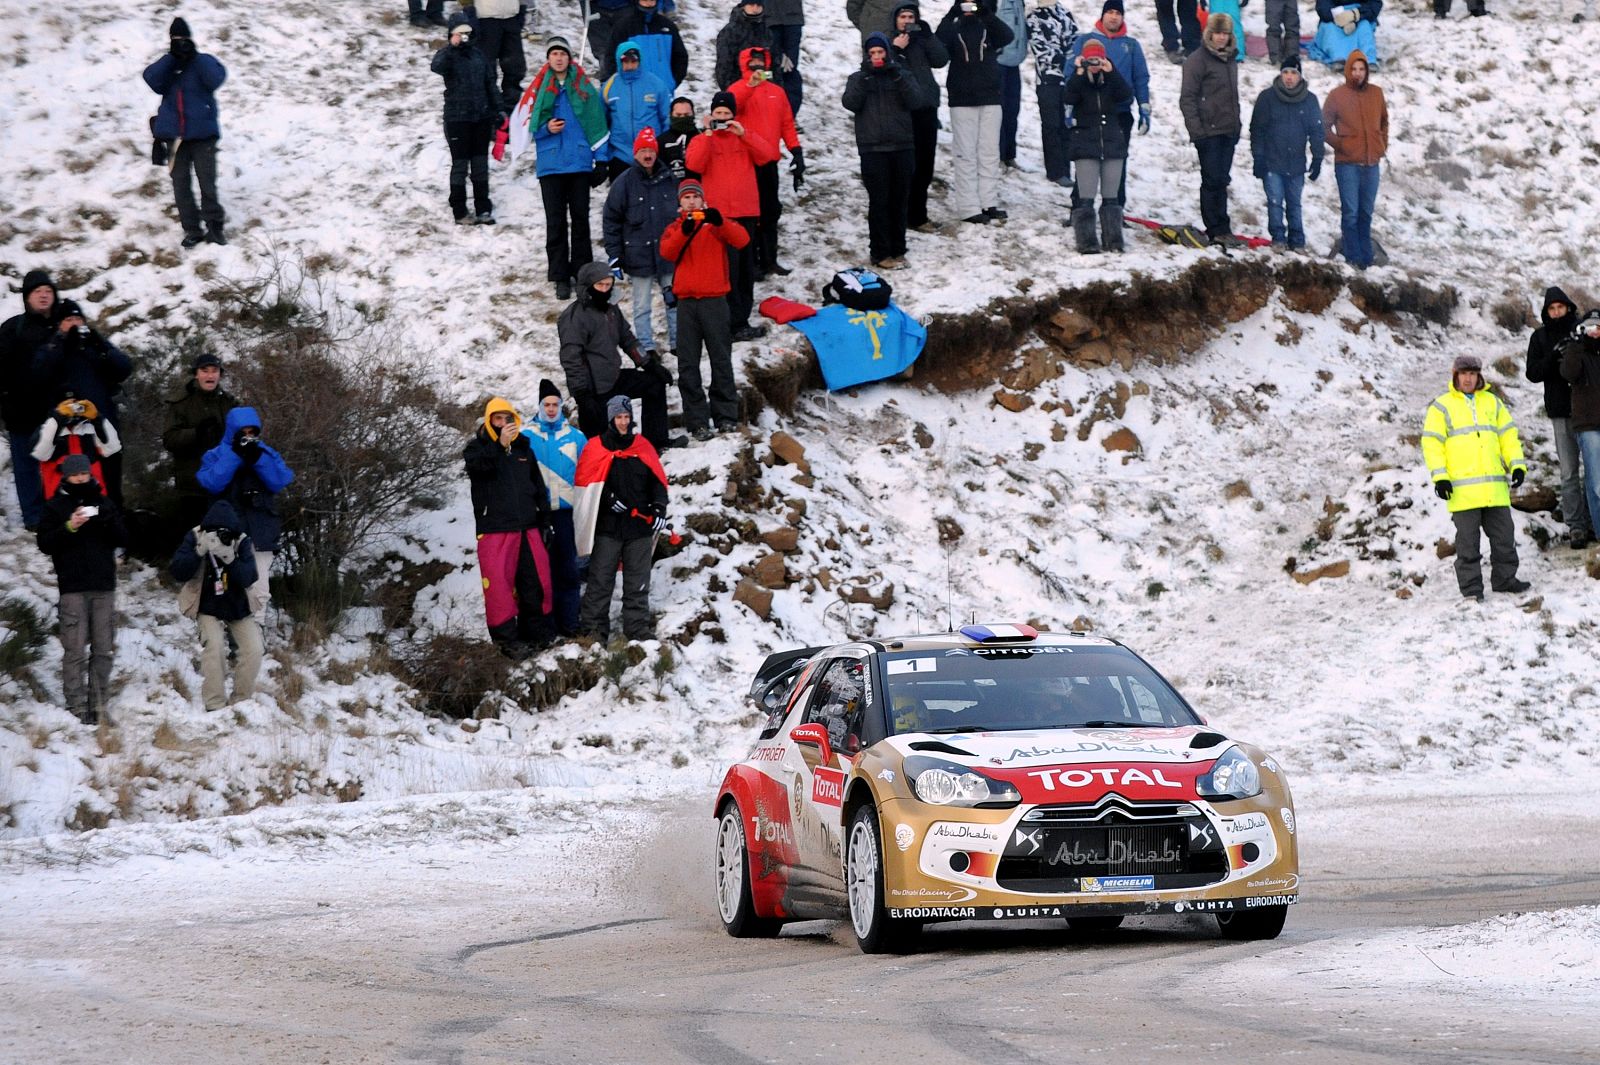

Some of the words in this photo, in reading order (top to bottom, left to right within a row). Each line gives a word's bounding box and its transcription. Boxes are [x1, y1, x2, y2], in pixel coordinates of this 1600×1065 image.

[906, 659, 918, 672] 1
[795, 729, 821, 737] TOTAL
[1027, 767, 1183, 792] TOTAL
[814, 774, 841, 801] TOTAL
[752, 816, 792, 845] TOTAL
[1103, 878, 1153, 887] MICHELIN
[919, 887, 953, 900] Racing
[890, 906, 976, 919] EURODATACAR
[1006, 907, 1061, 917] LUHTA
